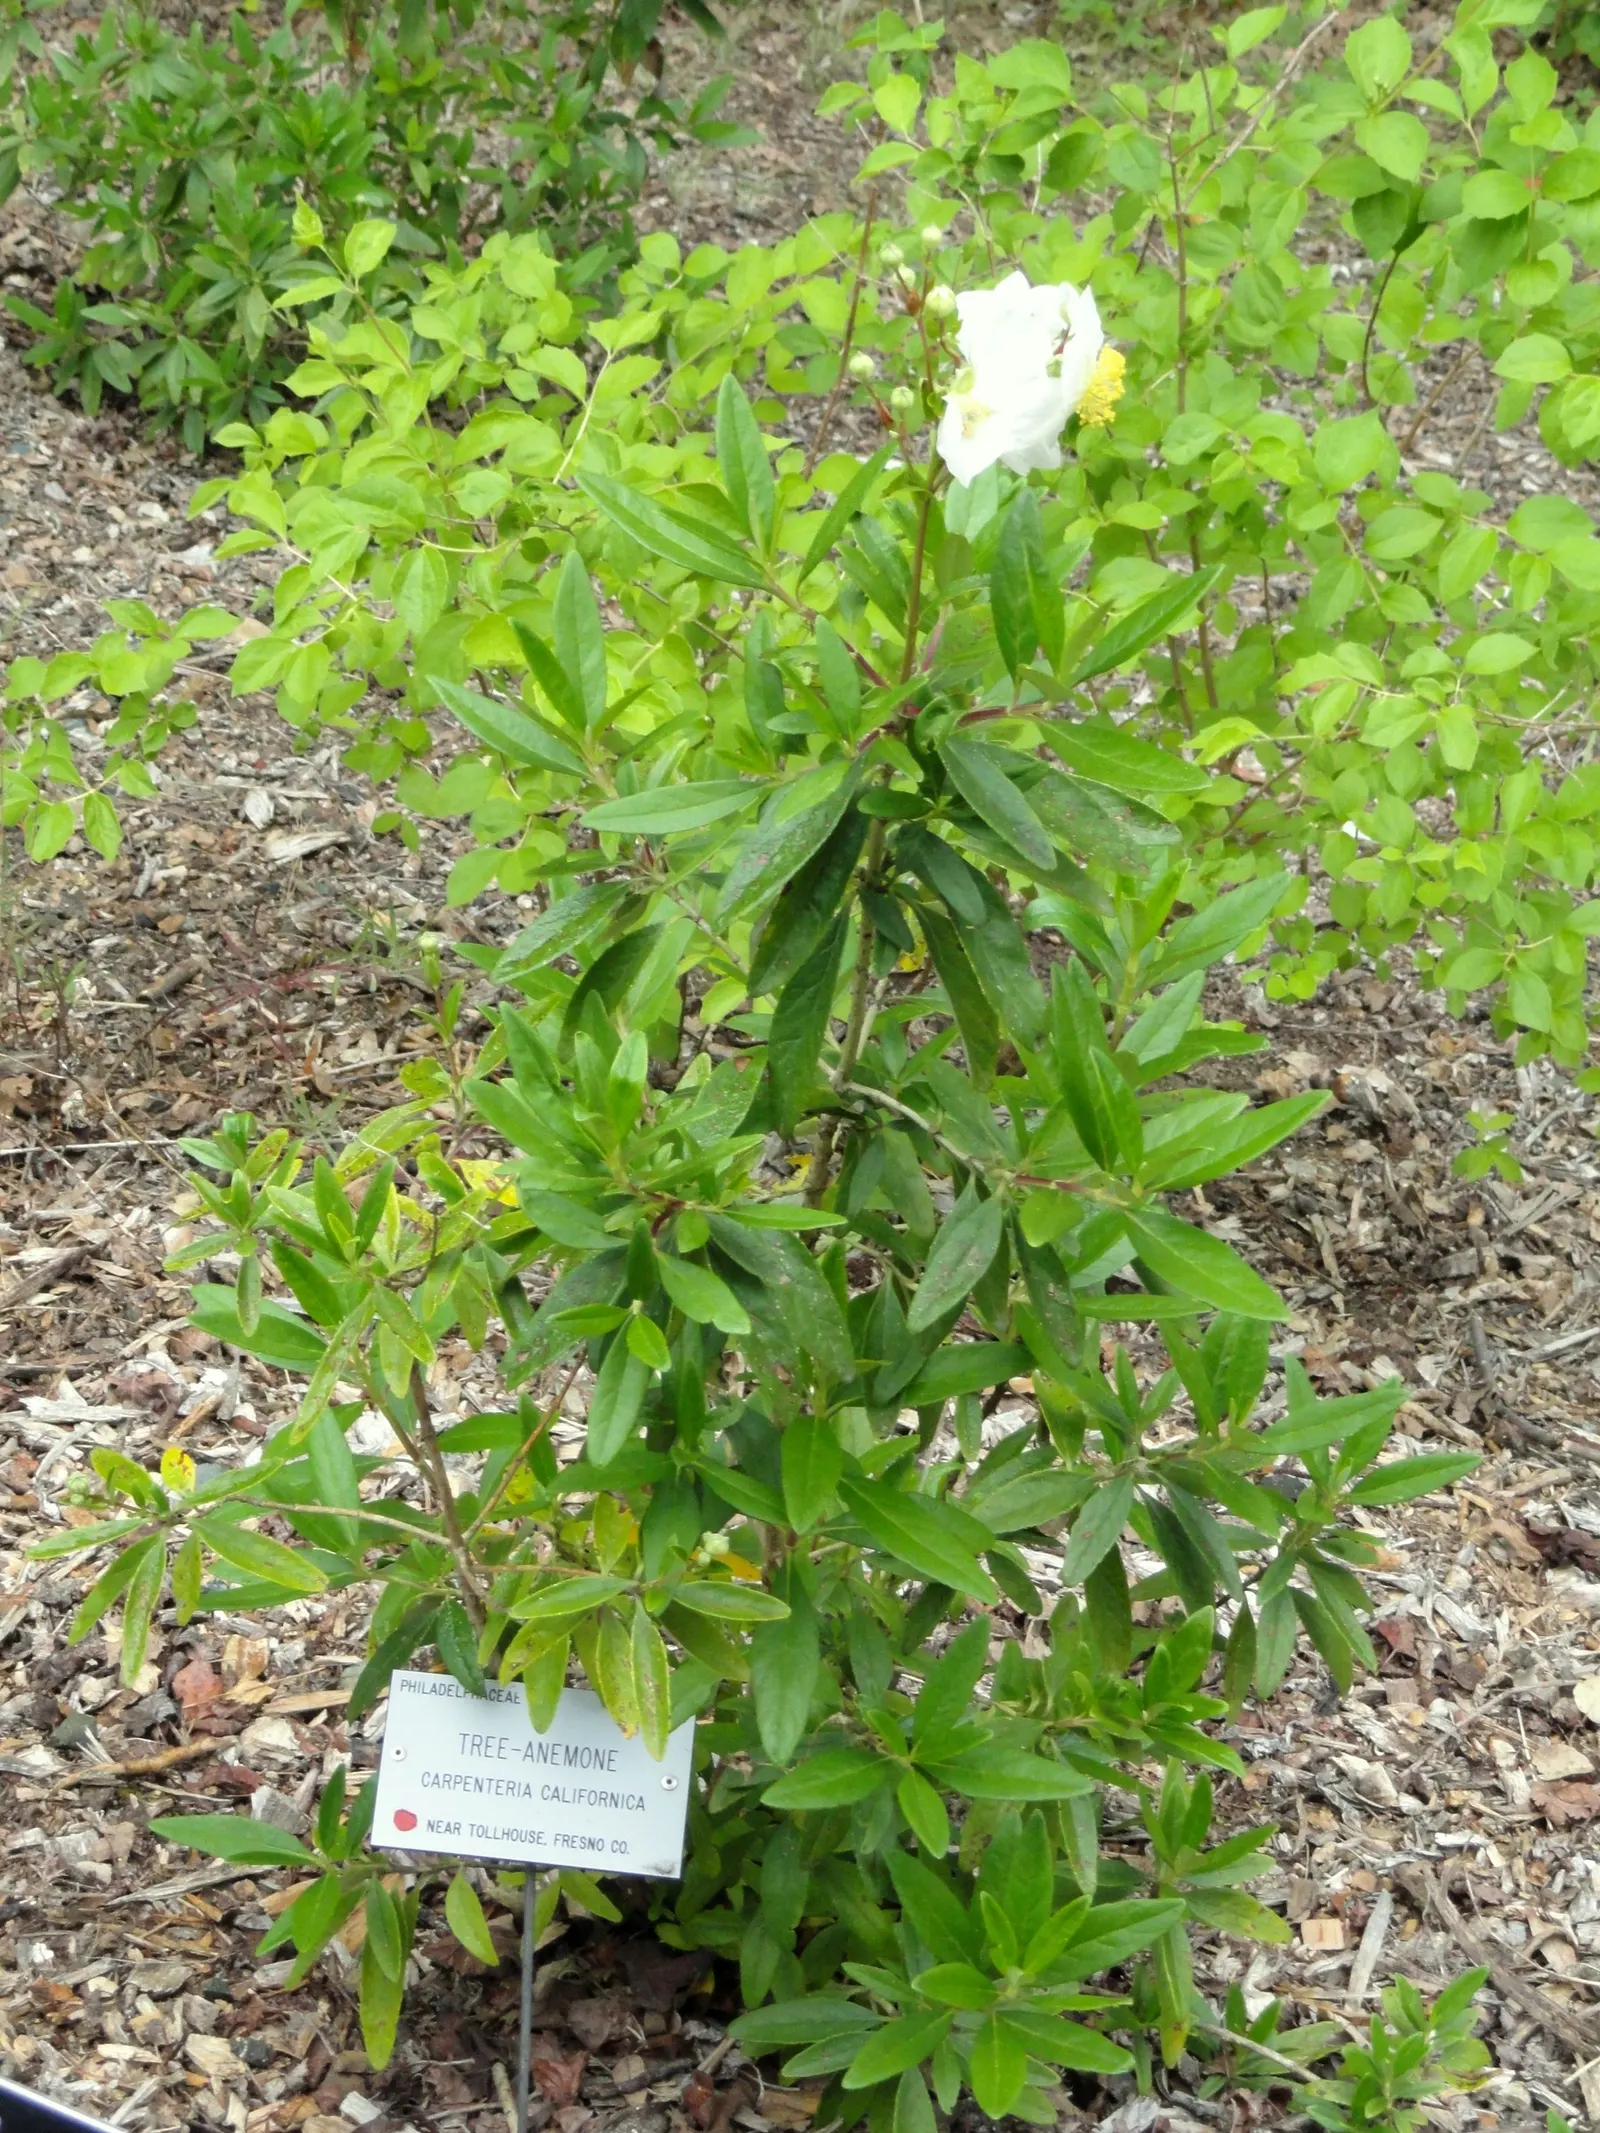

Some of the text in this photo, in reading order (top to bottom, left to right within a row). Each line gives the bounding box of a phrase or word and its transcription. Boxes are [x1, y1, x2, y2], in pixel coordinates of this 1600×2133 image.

[459, 1733, 619, 1772] TREE-ANEMONE
[421, 1771, 645, 1811] CARPENTERIA CALIFORNICA
[427, 1819, 461, 1835] NEAR
[554, 1833, 605, 1852] FRESNO
[610, 1840, 629, 1854] CO.
